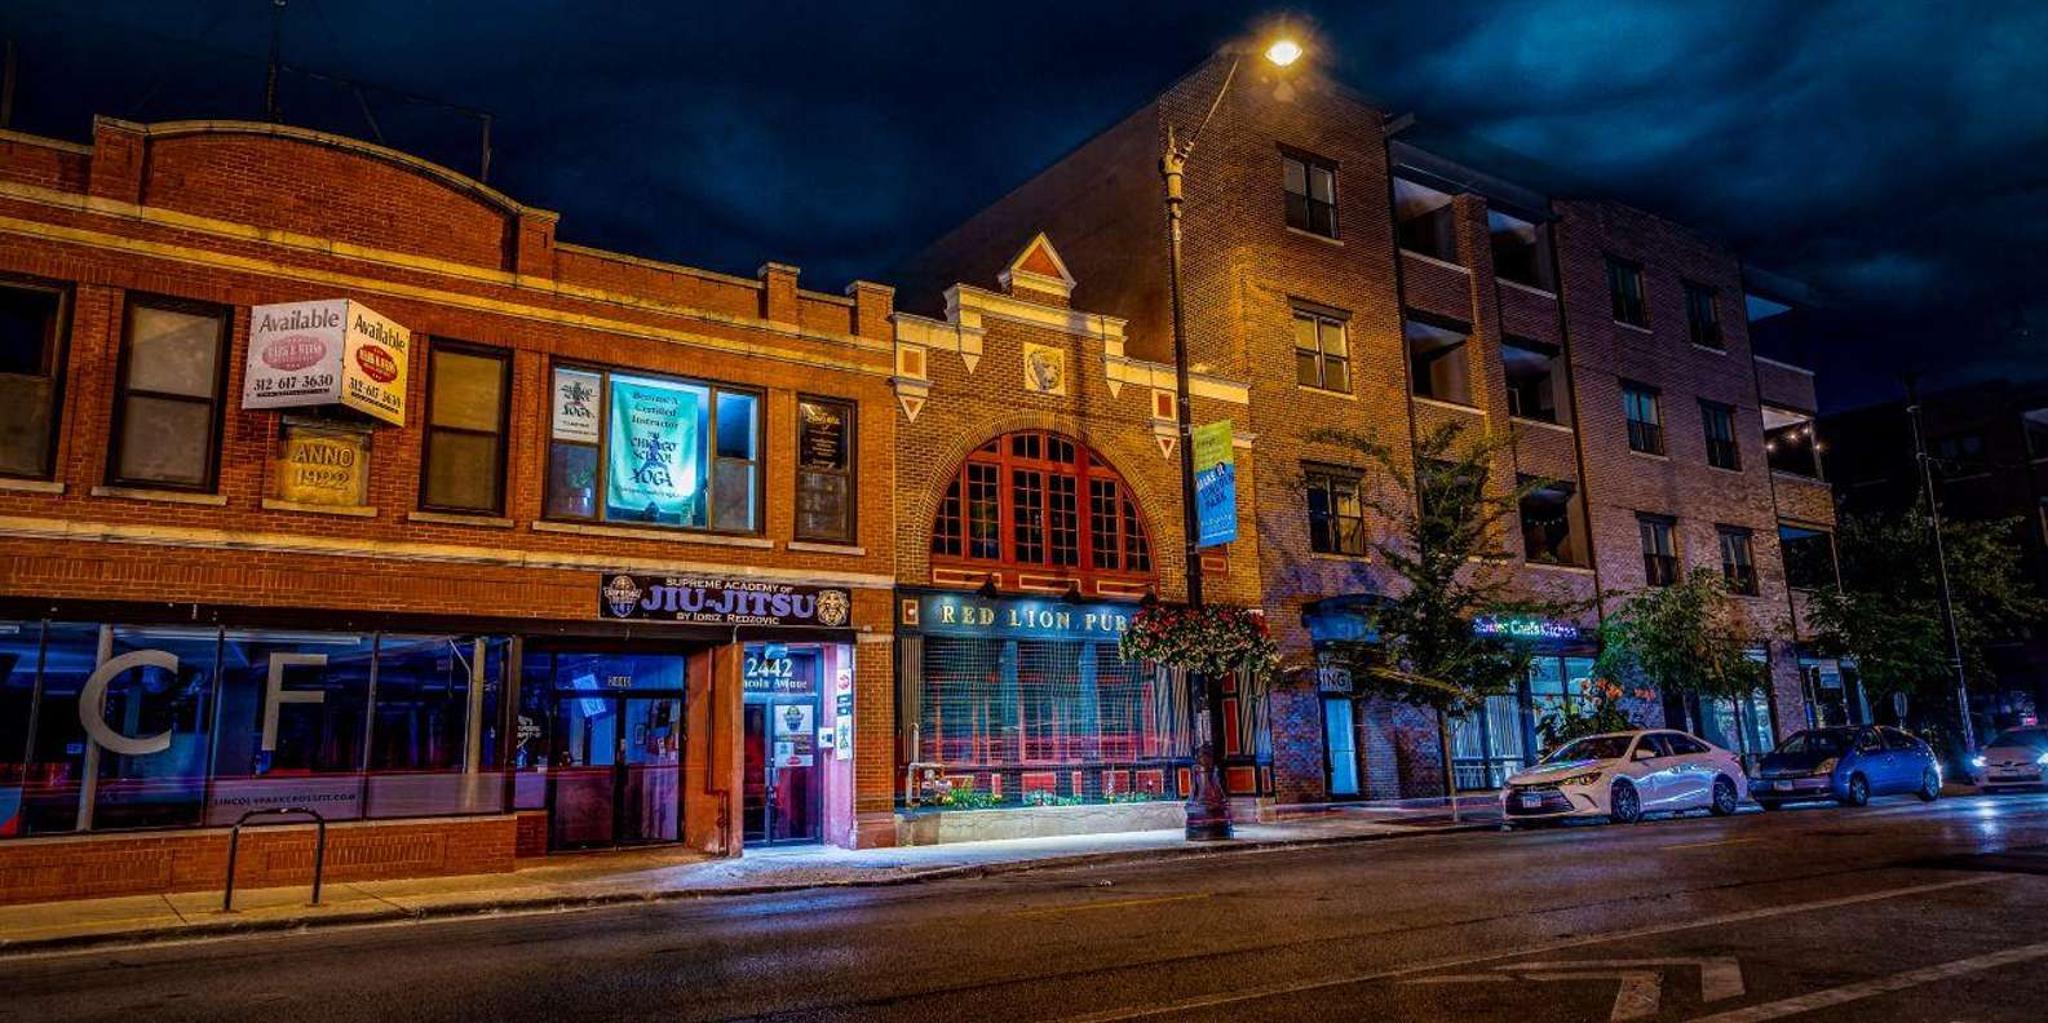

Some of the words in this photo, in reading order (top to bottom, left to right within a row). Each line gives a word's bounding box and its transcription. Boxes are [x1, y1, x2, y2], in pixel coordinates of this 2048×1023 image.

[259, 308, 339, 333] Available
[354, 314, 405, 351] Available
[634, 402, 677, 416] Certified
[632, 415, 679, 427] Instructor
[292, 444, 354, 467] ANNO
[630, 468, 673, 487] YOGA
[666, 577, 722, 589] SUPREME
[725, 582, 778, 592] ACADEMY
[641, 585, 816, 618] JIU-JITSU
[677, 612, 691, 620] BY
[693, 612, 722, 621] IDRIZ
[727, 614, 780, 625] REDZOVIC
[941, 604, 994, 625] RED
[1008, 609, 1070, 630] LION
[1085, 613, 1129, 632] PUB
[747, 657, 793, 677] 2442
[744, 678, 769, 688] ncoln
[1320, 671, 1347, 687] ING
[79, 649, 179, 755] C
[261, 652, 327, 752] F
